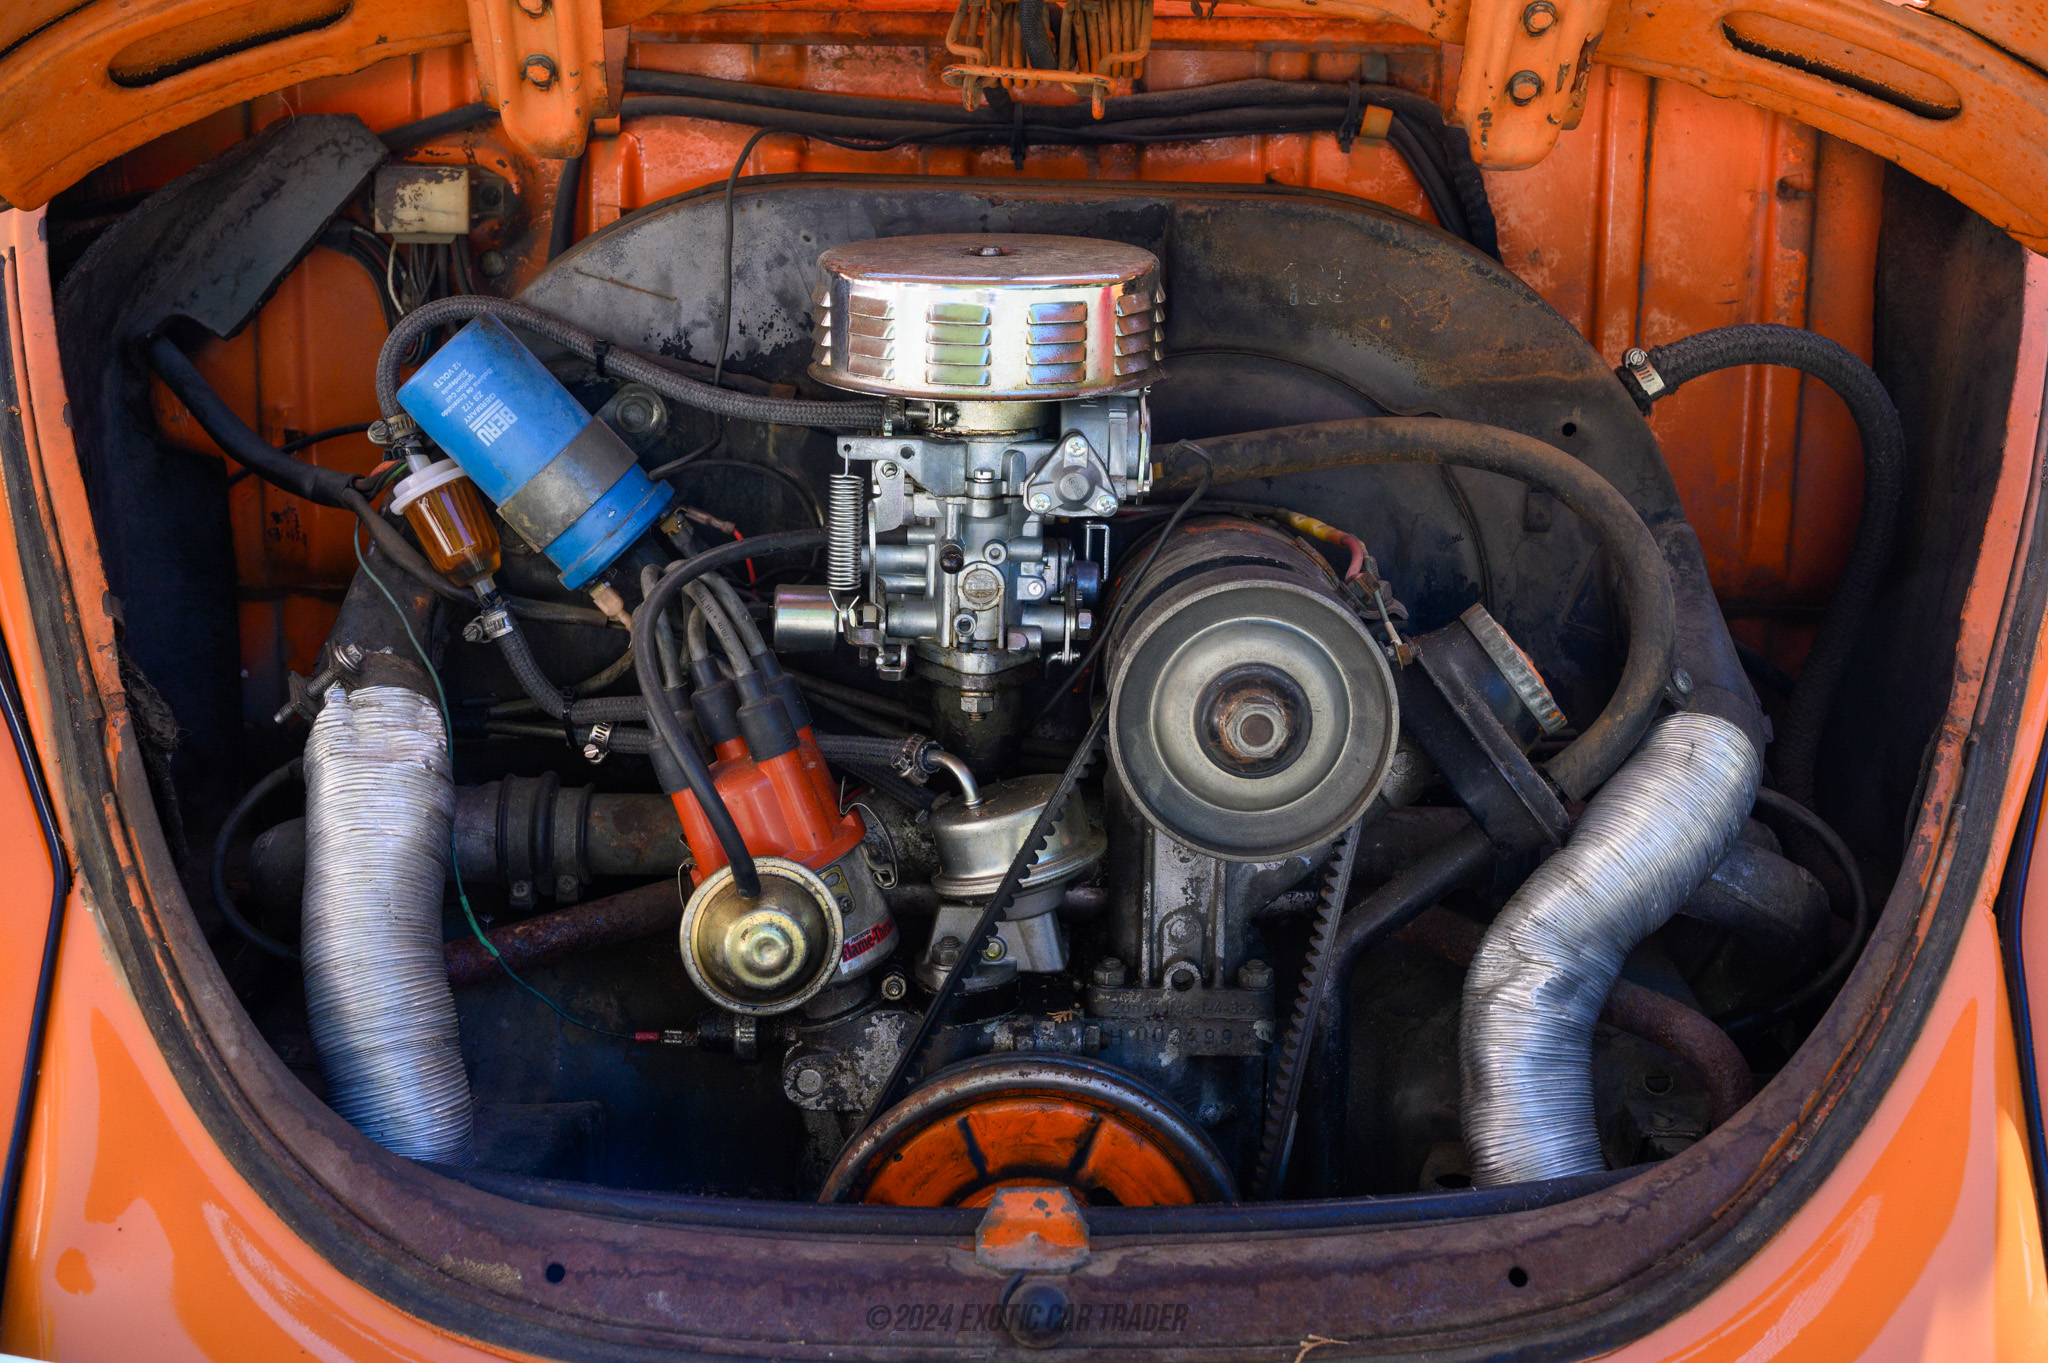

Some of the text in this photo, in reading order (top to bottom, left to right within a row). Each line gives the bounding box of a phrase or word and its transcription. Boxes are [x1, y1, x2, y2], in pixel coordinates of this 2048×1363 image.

[433, 361, 462, 389] 12 VOLTS
[445, 373, 477, 403] Ignition Coil
[461, 390, 484, 412] ZS 172
[466, 386, 474, 394] de
[441, 393, 468, 417] Encendido
[464, 393, 496, 424] GERMANY
[477, 405, 518, 447] BERU
